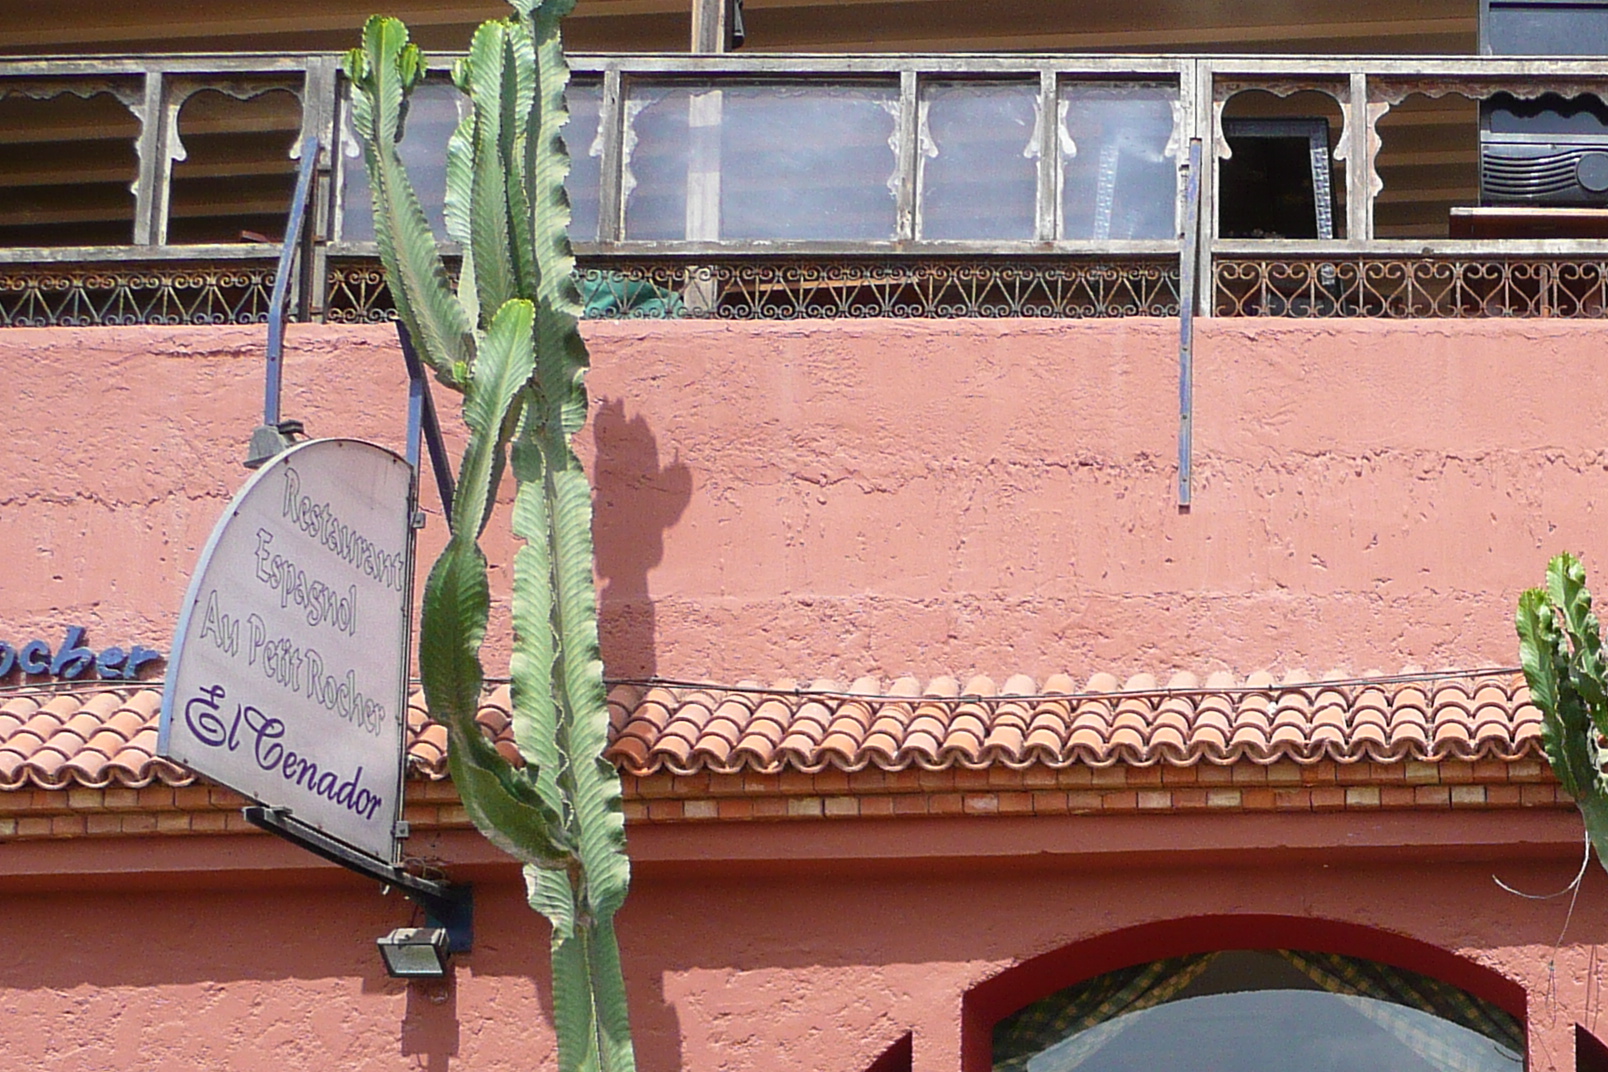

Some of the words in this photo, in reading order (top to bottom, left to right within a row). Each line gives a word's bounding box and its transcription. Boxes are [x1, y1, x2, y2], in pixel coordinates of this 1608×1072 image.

[254, 528, 357, 637] Espagnol
[283, 467, 404, 592] Restaurant
[200, 589, 240, 658] Au
[247, 613, 303, 693] Petit
[304, 648, 386, 737] Rocher
[184, 684, 242, 752] El
[243, 704, 382, 821] Cenador
